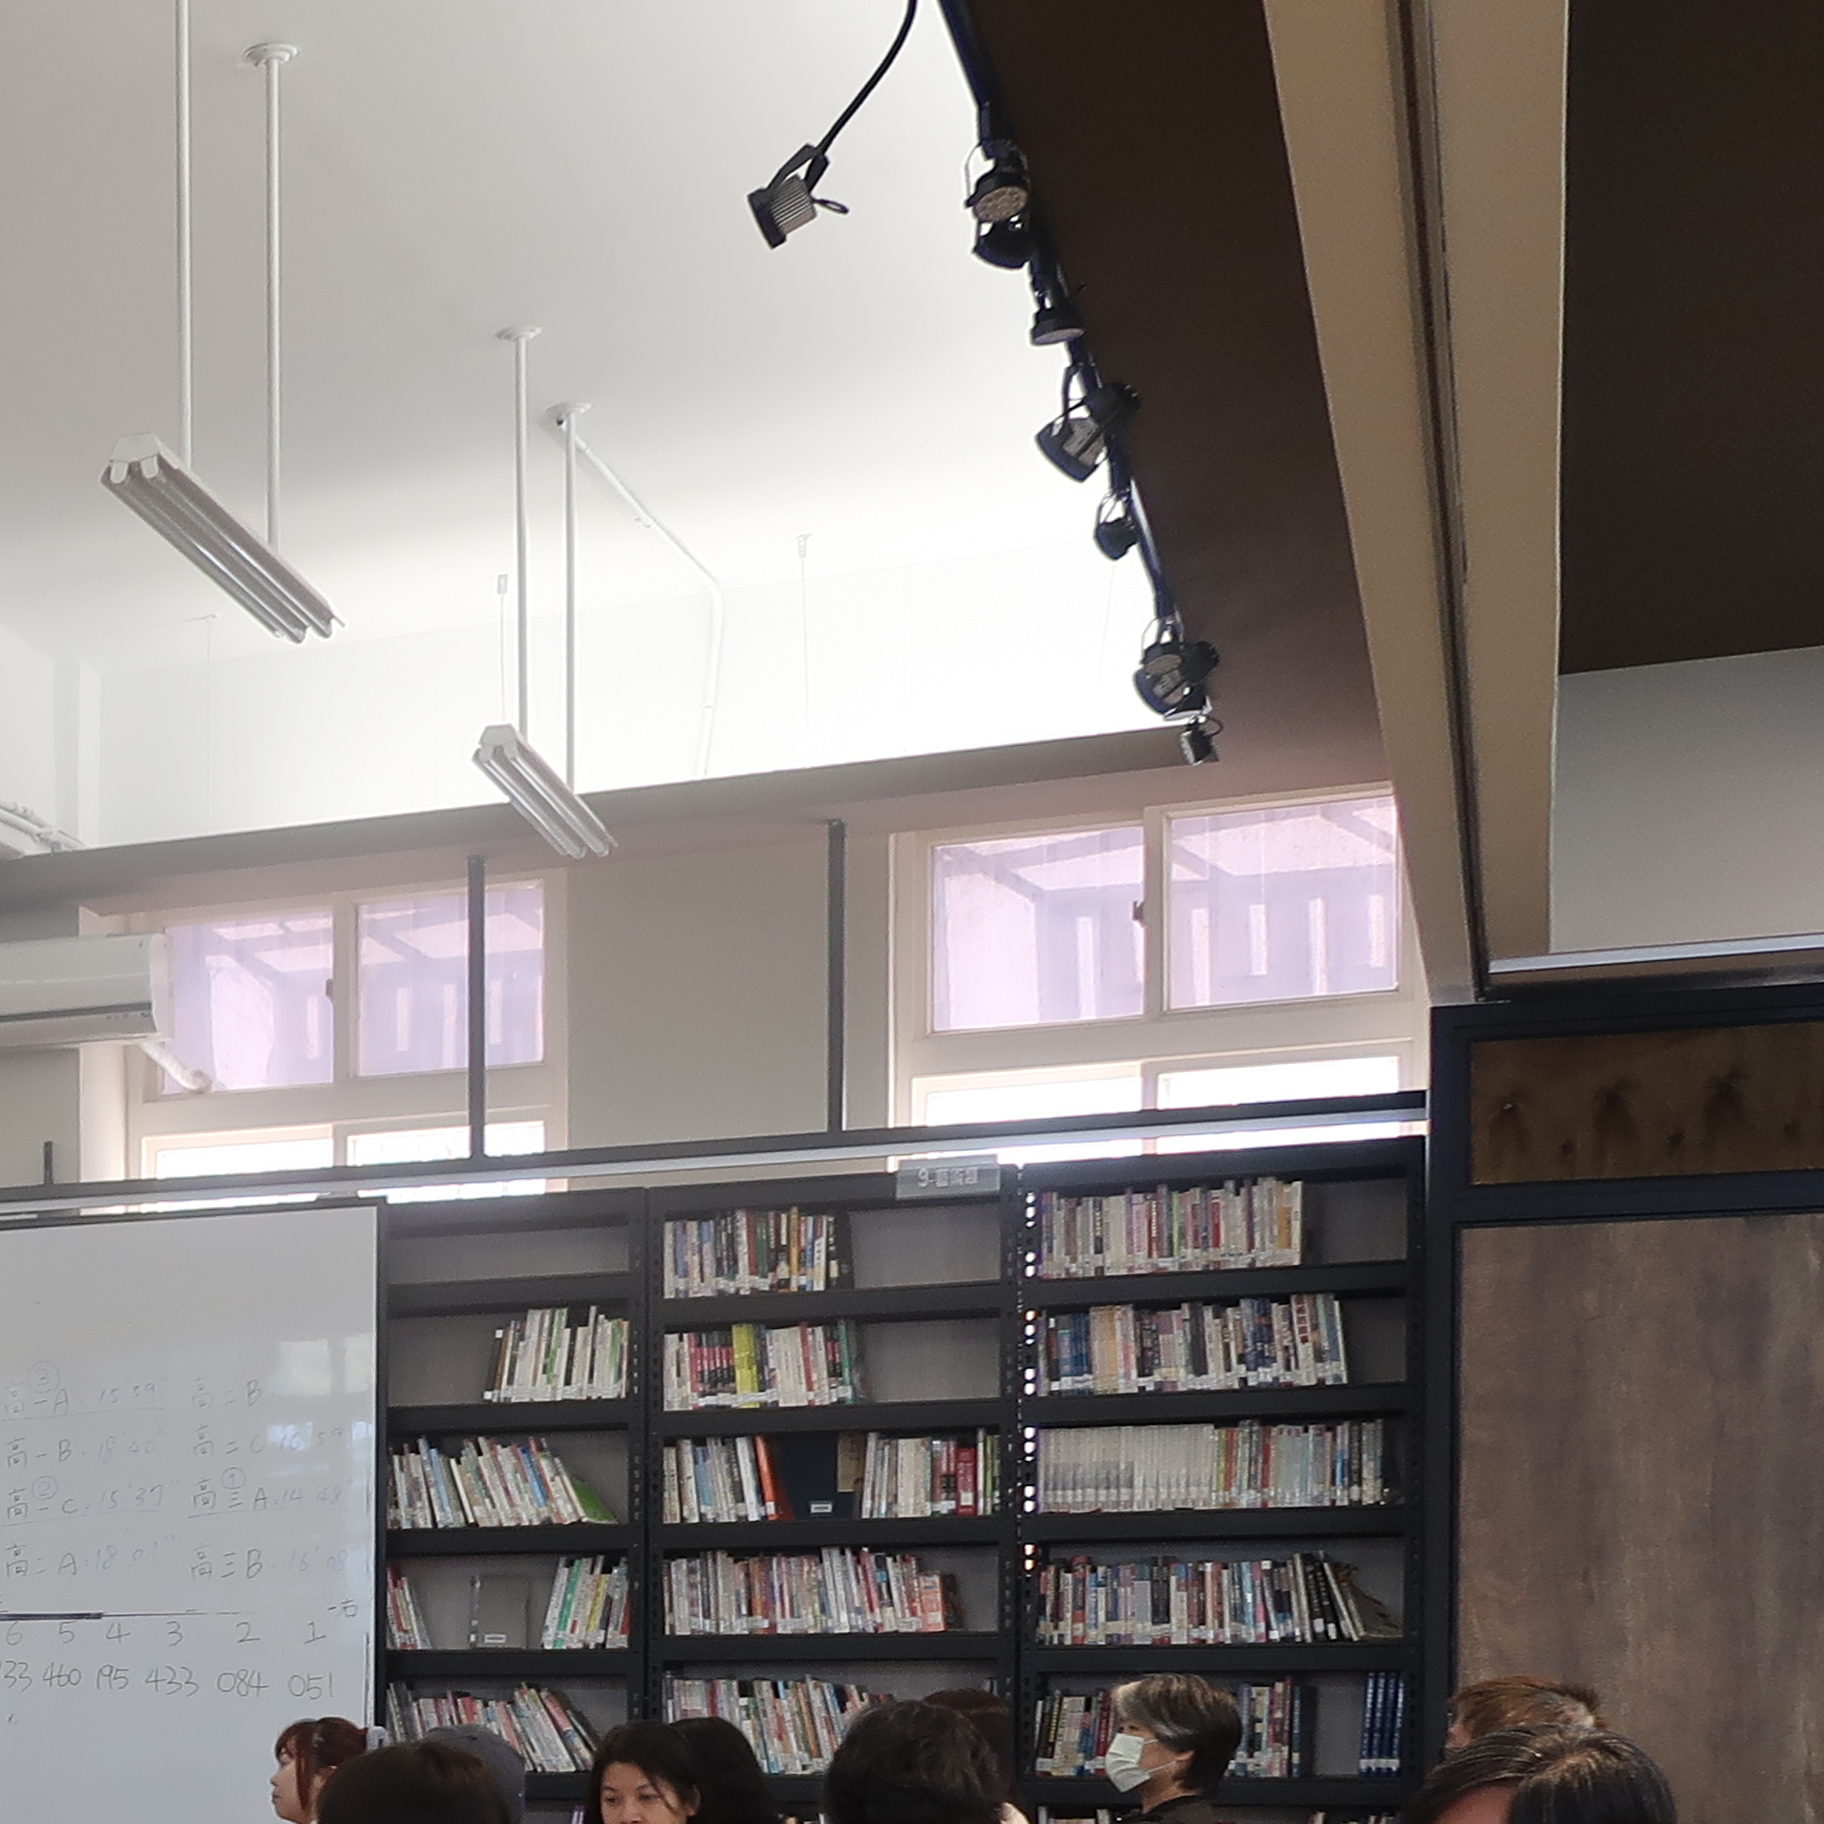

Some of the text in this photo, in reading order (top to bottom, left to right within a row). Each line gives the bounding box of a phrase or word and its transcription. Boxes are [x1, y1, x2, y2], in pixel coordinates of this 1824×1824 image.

[58, 1621, 76, 1643] 5
[106, 1621, 131, 1641] 4
[167, 1621, 183, 1646] 3
[236, 1622, 261, 1643] 2
[304, 1622, 327, 1644] 1
